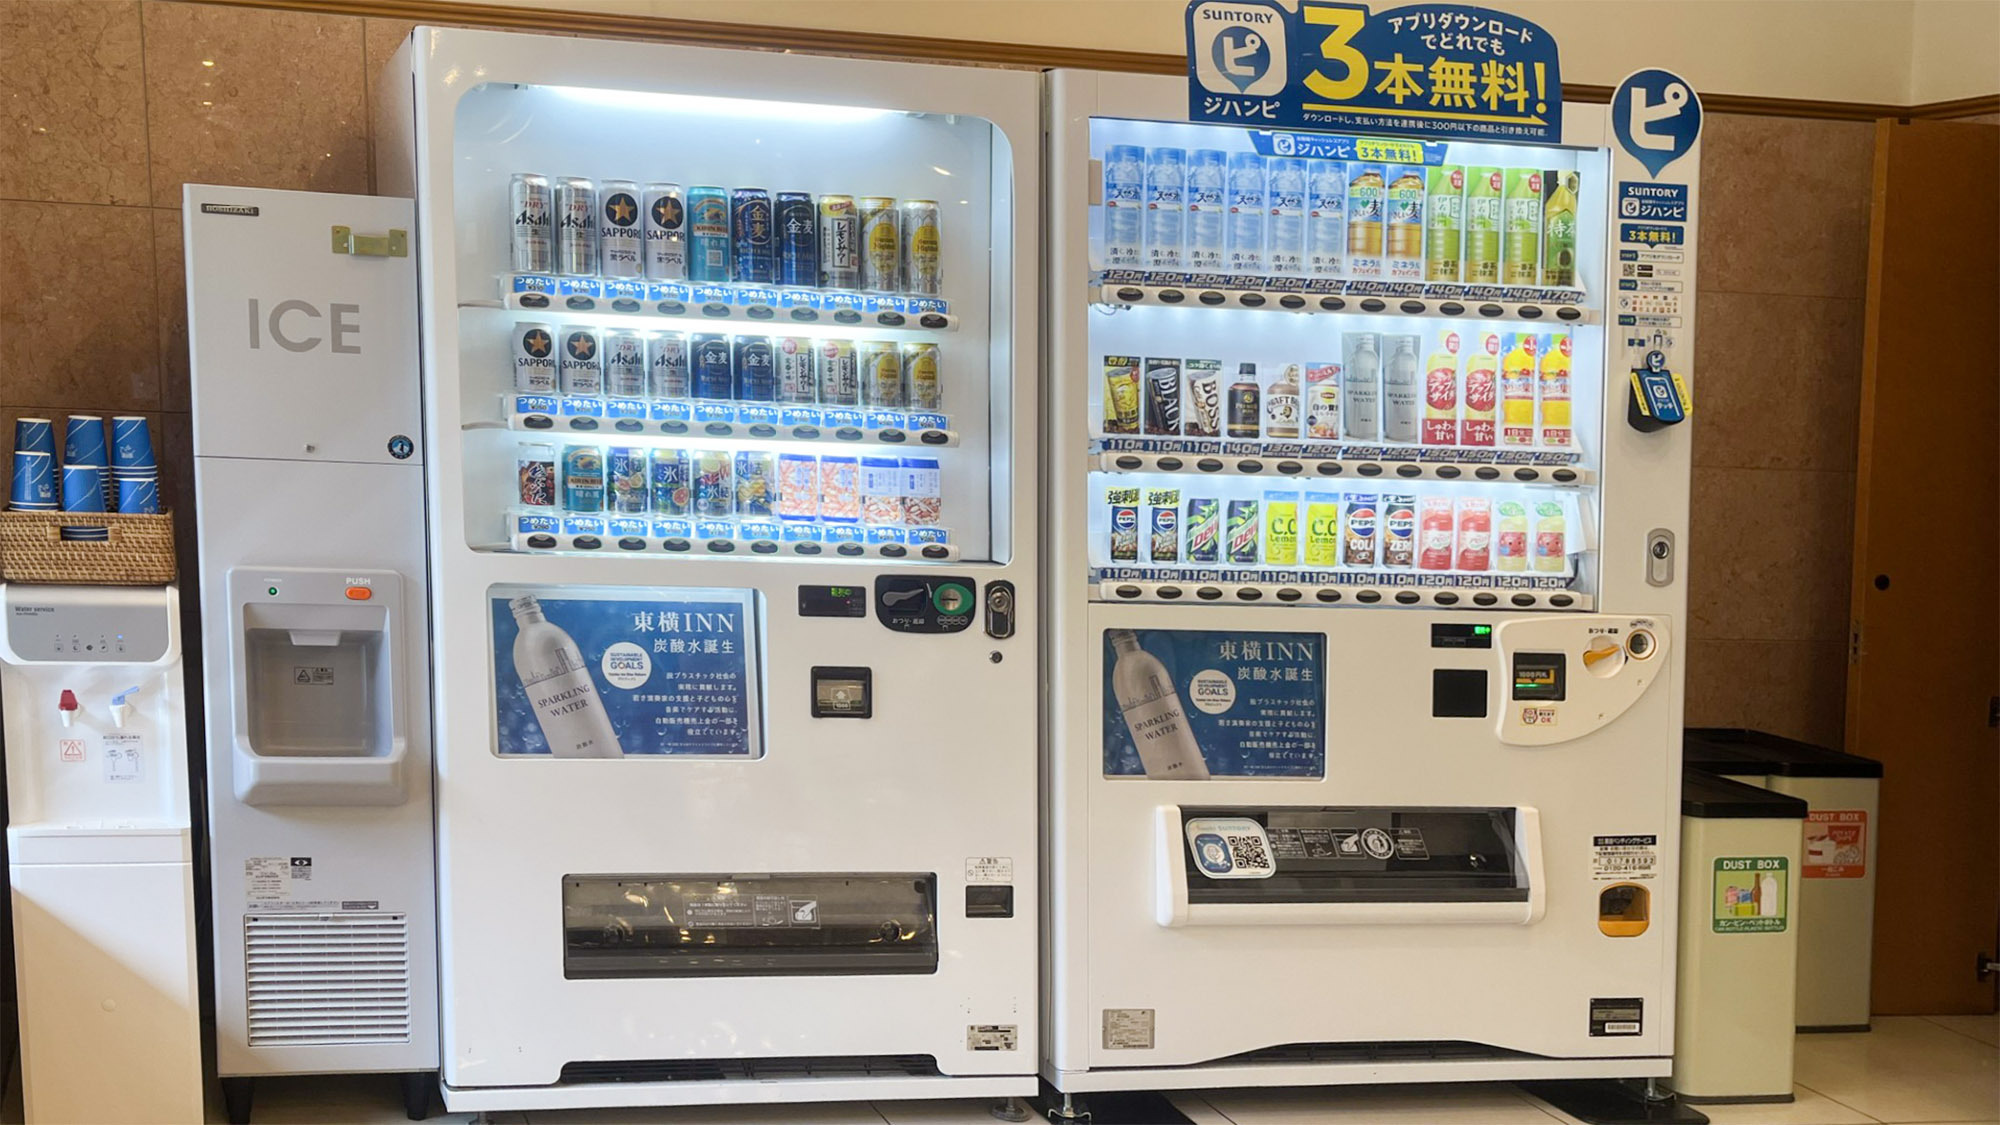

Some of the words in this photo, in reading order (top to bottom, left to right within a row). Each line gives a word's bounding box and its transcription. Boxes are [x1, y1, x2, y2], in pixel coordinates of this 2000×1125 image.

[1203, 9, 1274, 24] SUNTORY
[1388, 11, 1533, 44] アプリダウンロード
[1420, 33, 1506, 56] でどれでも
[1222, 33, 1262, 76] ピ
[1204, 96, 1281, 119] ジハンピ
[1629, 82, 1688, 151] ピ
[1297, 143, 1350, 159] ジハンピ
[1360, 187, 1377, 197] 600
[1399, 189, 1416, 199] 600
[1628, 186, 1680, 198] SUNTORY
[1641, 206, 1685, 218] ジハンピ
[750, 205, 766, 239] 金麦
[787, 217, 814, 234] 金麦
[517, 278, 554, 286] つめたい
[561, 279, 599, 289] つめたい
[607, 281, 645, 291] つめたい
[652, 284, 688, 294] つめたい
[695, 286, 732, 296] つめたい
[741, 290, 777, 299] つめたい
[784, 292, 820, 301] つめたい
[826, 295, 862, 304] つめたい
[869, 297, 904, 306] つめたい
[912, 299, 946, 309] つめたい
[248, 298, 361, 354] ICE
[704, 351, 728, 365] 金麦
[747, 353, 771, 367] 金麦
[519, 397, 557, 406] つめたい
[564, 399, 602, 408] つめたい
[609, 401, 647, 410] つめたい
[1159, 376, 1181, 431] BLACK
[1202, 380, 1220, 430] BOSS
[654, 403, 690, 412] つめたい
[697, 405, 733, 414] つめたい
[741, 407, 778, 415] つめたい
[784, 409, 820, 417] つめたい
[826, 411, 863, 420] つめたい
[869, 413, 904, 422] つめたい
[911, 415, 945, 424] つめたい
[1435, 431, 1454, 440] 甘い
[1475, 432, 1493, 442] 甘い
[521, 517, 559, 525] つめたい
[566, 518, 604, 527] つめたい
[611, 519, 647, 529] つめたい
[655, 521, 691, 530] つめたい
[699, 523, 734, 531] つめたい
[744, 524, 779, 533] つめたい
[785, 526, 821, 534] つめたい
[827, 527, 863, 536] つめたい
[869, 529, 904, 538] つめたい
[911, 530, 945, 539] つめたい
[346, 577, 371, 585] PUSH
[631, 611, 735, 633] 東横INN
[653, 638, 735, 654] 炭酸水誕生
[1219, 640, 1314, 662] 東横INN
[610, 662, 644, 670] GOALS
[1237, 667, 1314, 681] 炭酸水誕生
[538, 684, 591, 709] SPARKLING
[1198, 688, 1229, 696] GOALS
[550, 698, 589, 717] WATER
[1134, 708, 1181, 731] SPARKLING
[1145, 723, 1179, 741] WATER
[1809, 813, 1835, 821] DUST
[1840, 813, 1860, 821] BOX
[1723, 860, 1751, 869] DUST
[1757, 859, 1780, 868] BOX
